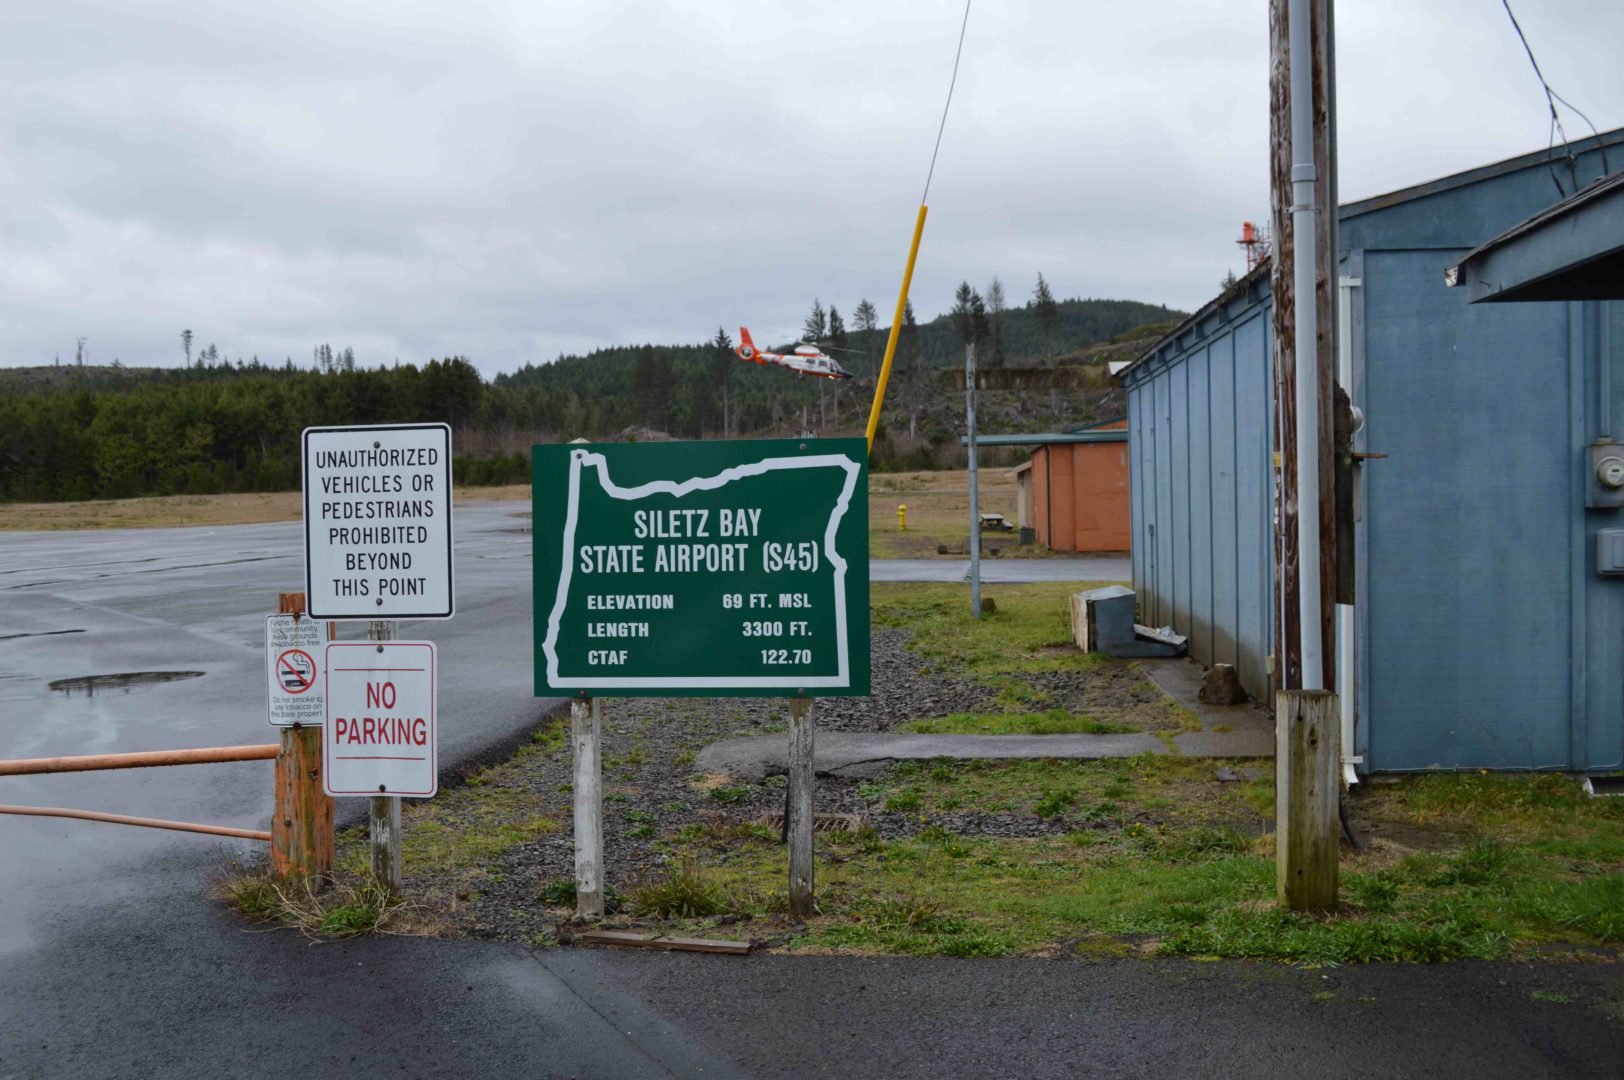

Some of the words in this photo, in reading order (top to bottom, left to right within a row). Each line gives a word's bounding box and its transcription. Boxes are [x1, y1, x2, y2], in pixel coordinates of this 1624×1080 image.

[316, 448, 438, 468] UNAUTHORIZED
[321, 475, 403, 494] VEHICLES
[411, 474, 434, 492] OR
[322, 500, 434, 519] PEDESTRIANS
[634, 510, 709, 539] SILETZ
[720, 508, 762, 537] BAY
[329, 526, 428, 545] PROHIBITED
[346, 552, 412, 570] BEYOND
[580, 545, 645, 574] STATE
[655, 544, 749, 573] AIRPORT
[763, 541, 819, 574] (S45)
[332, 579, 370, 596] THIS
[379, 578, 427, 596] POINT
[587, 595, 674, 610] ELEVATION
[722, 593, 743, 609] 69
[749, 593, 772, 608] FT.
[779, 593, 812, 608] MSL
[587, 623, 649, 638] LENGTH
[742, 622, 783, 637] 3300
[790, 622, 812, 637] FT.
[588, 650, 628, 665] CTAF
[761, 649, 812, 664] 122.70
[366, 681, 397, 709] NO
[297, 710, 323, 718] propert
[335, 717, 427, 746] PARKING
